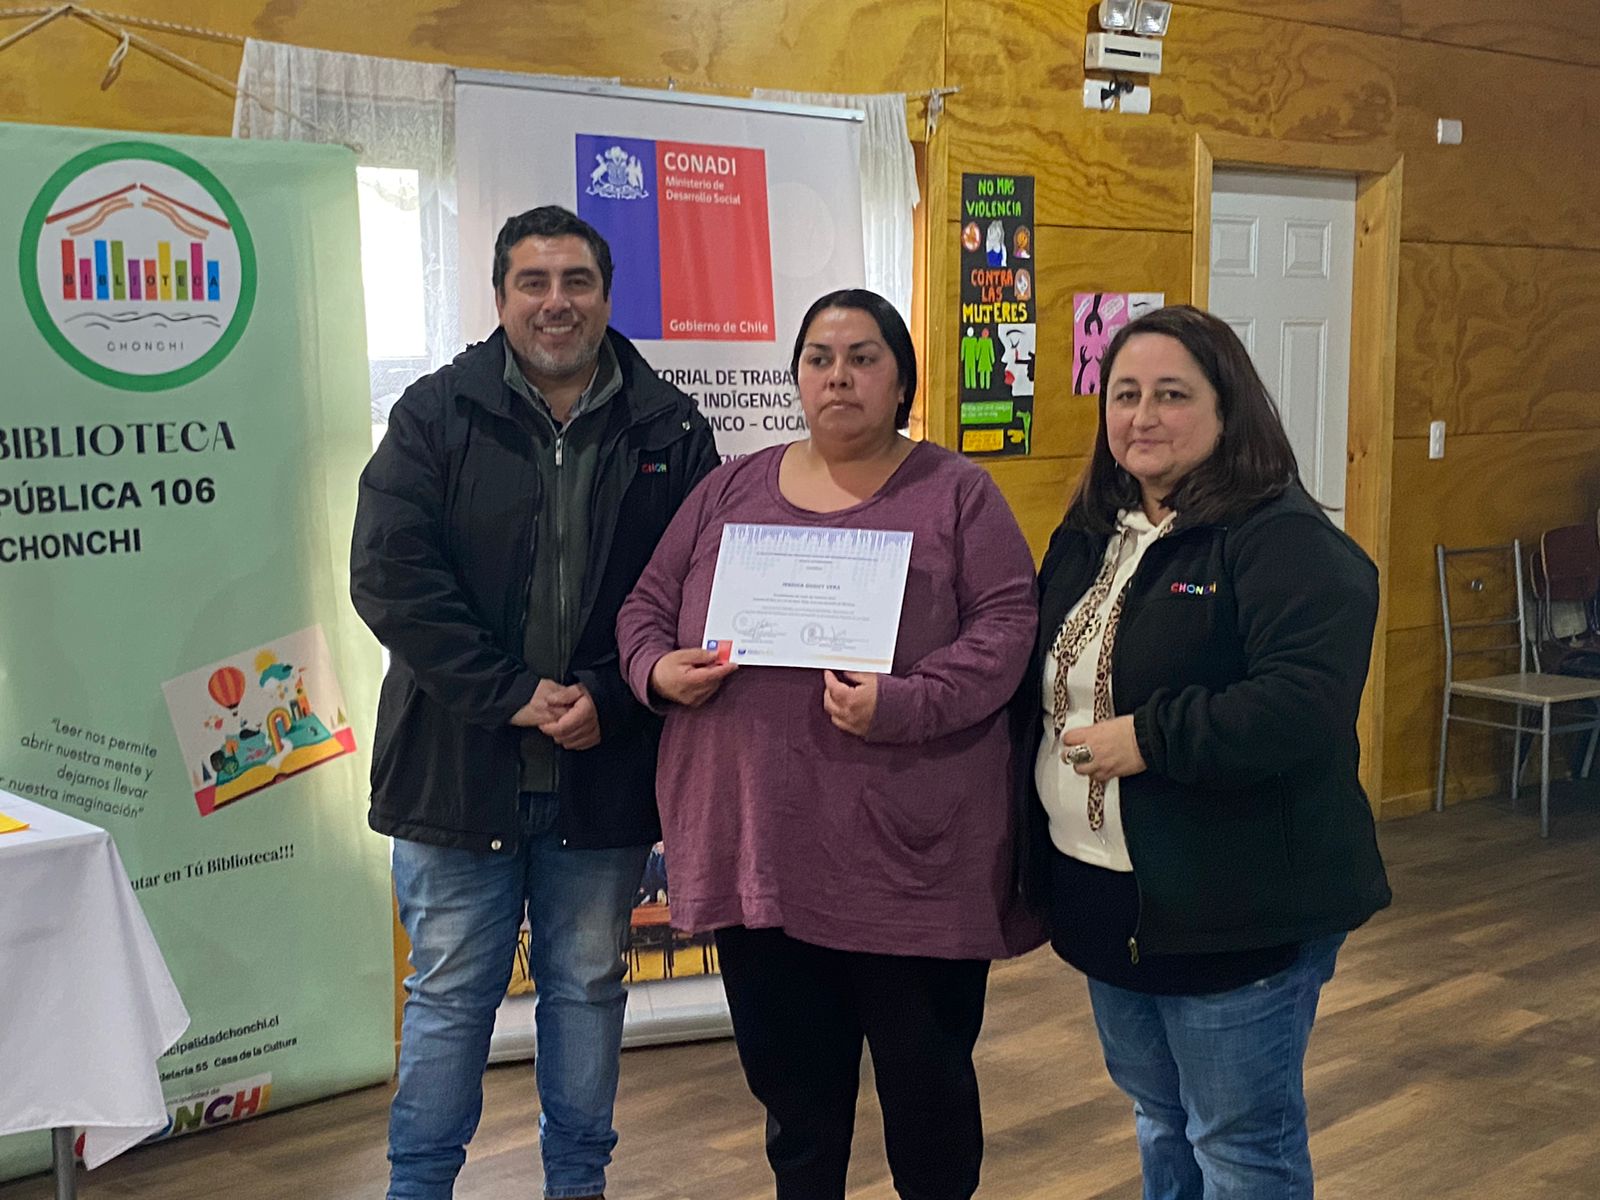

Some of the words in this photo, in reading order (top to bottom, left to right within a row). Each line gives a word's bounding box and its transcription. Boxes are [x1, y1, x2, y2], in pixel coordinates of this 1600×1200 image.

[664, 152, 736, 176] CONADI
[665, 176, 712, 190] Ministerio
[713, 179, 724, 191] de
[978, 179, 994, 196] NO
[997, 177, 1015, 196] MAS
[666, 189, 712, 204] Desarrollo
[714, 193, 741, 205] Social
[966, 199, 1022, 218] VIOLENCIA
[65, 273, 219, 287] BIBLIOTECA
[971, 268, 1013, 287] CONTRA
[982, 286, 1003, 302] LAS
[963, 302, 1028, 324] MUJERES
[669, 319, 720, 333] Gobierno
[723, 320, 736, 333] de
[739, 320, 769, 334] Chile
[107, 340, 185, 352] CHONCHI
[716, 369, 737, 386] DE
[740, 369, 796, 386] TRABA
[704, 390, 792, 409] INDÍGENAS
[706, 415, 745, 432] NCO
[763, 415, 811, 431] CUCA
[0, 480, 142, 517] PÚBLICA
[151, 477, 216, 507] 106
[0, 528, 141, 563] CHONCHI
[85, 730, 106, 745] nos
[108, 736, 158, 759] permite
[21, 733, 54, 751] abrir
[56, 744, 101, 765] nuestra
[104, 757, 142, 776] mente
[145, 768, 153, 783] y
[8, 778, 58, 800] nuestra
[113, 777, 149, 800] llevar
[131, 873, 161, 892] utar
[164, 870, 181, 884] en
[184, 861, 203, 879] Tú
[207, 843, 295, 875] Biblioteca!!!
[213, 1057, 239, 1068] Casa
[239, 1050, 251, 1060] de
[253, 1045, 262, 1056] la
[263, 1037, 298, 1053] Cultura
